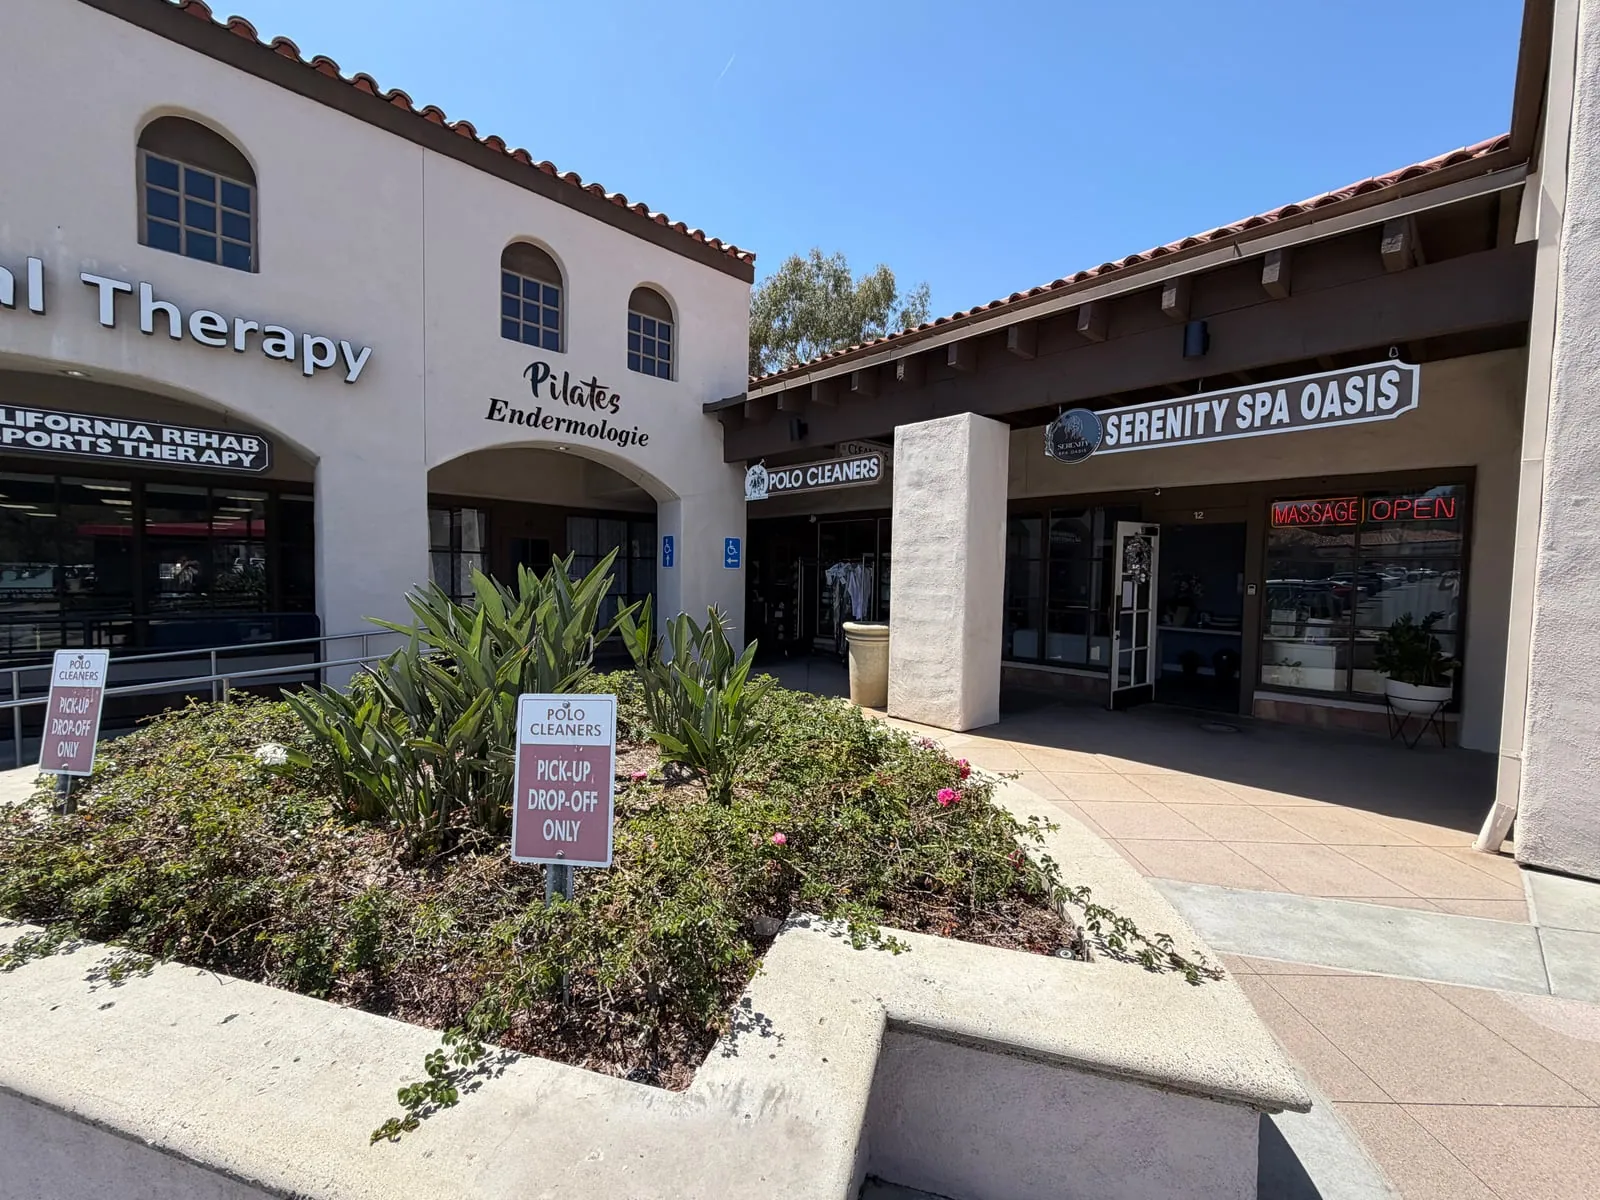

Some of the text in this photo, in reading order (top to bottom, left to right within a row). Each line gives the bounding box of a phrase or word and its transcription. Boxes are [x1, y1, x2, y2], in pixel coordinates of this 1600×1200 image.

[79, 272, 372, 382] Therapy
[523, 361, 621, 415] Pilates
[1105, 369, 1400, 446] SERENITY SPA OASIS
[485, 397, 649, 448] Endermologie
[162, 428, 259, 453] REHAB
[118, 440, 256, 467] THERAPY
[769, 457, 878, 490] POLO CLEANERS
[1193, 511, 1204, 520] 12
[1275, 500, 1357, 524] MASSAGE
[1371, 497, 1455, 520] OPEN
[59, 671, 99, 681] CLEANERS
[69, 660, 91, 670] POLO
[60, 697, 90, 714] PICK-UP
[547, 708, 585, 721] POLO
[52, 719, 92, 736] DROP-OFF
[530, 723, 602, 737] CLEANERS
[57, 742, 80, 758] ONLY
[537, 760, 591, 783] PICK-UP
[528, 789, 598, 812] DROP-OFF
[543, 819, 581, 842] ONLY
